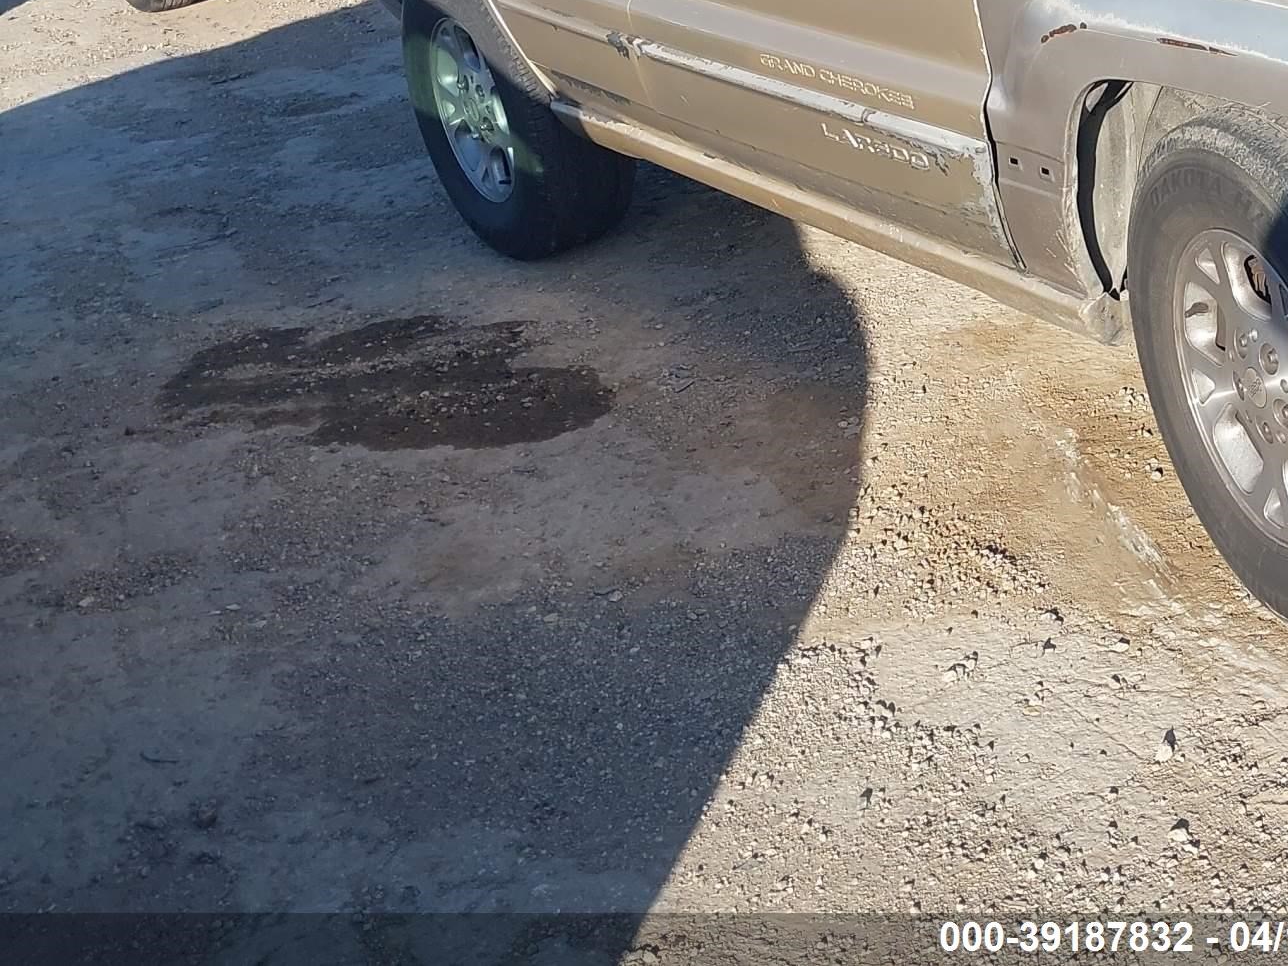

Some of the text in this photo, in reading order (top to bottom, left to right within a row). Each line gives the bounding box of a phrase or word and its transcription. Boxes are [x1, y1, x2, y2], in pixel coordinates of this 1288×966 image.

[759, 53, 916, 110] GRAND CHEROKEE
[820, 122, 930, 170] LAREDO
